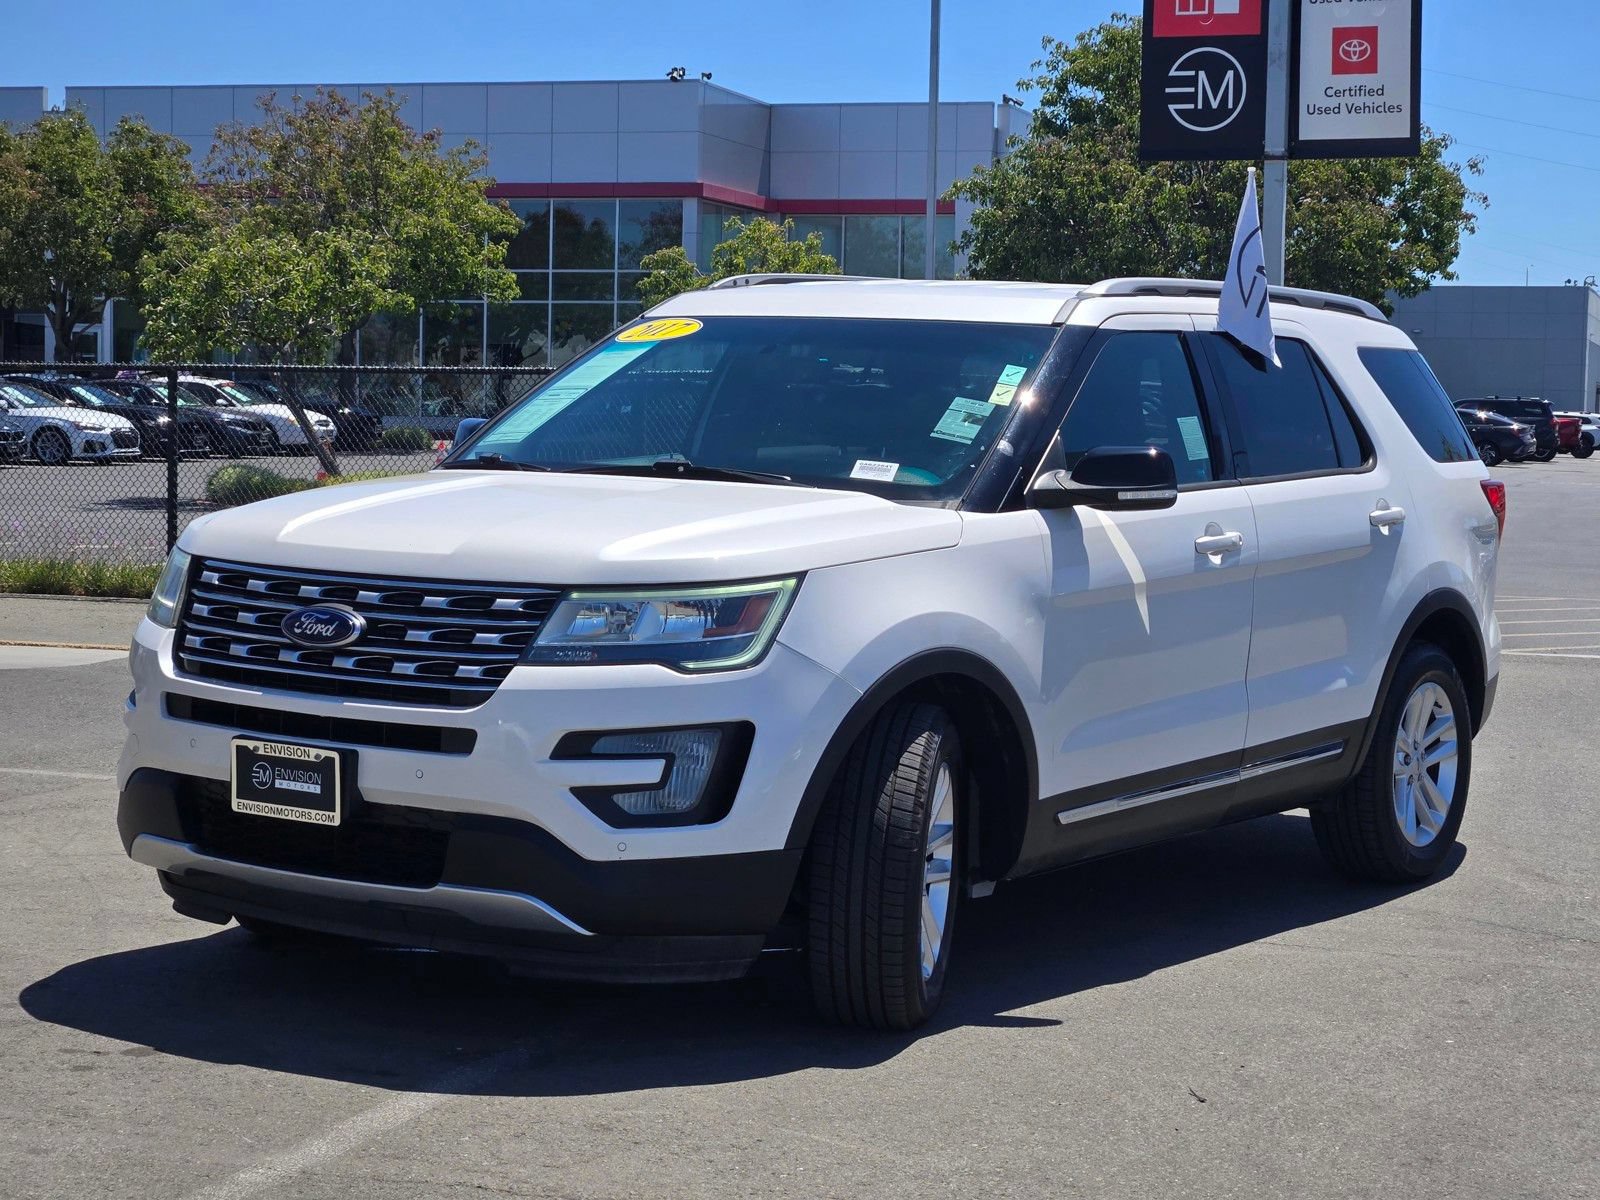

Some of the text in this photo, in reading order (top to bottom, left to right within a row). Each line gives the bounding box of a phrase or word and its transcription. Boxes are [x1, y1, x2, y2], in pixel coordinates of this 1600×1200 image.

[1324, 84, 1385, 98] Certified
[1306, 101, 1403, 116] Used Vehicles
[293, 611, 339, 637] Ford
[263, 743, 311, 759] ENVISION
[274, 767, 322, 785] ENVISION
[278, 781, 318, 792] MOTORS
[236, 801, 336, 824] ENVISIONMOTORS.COM
